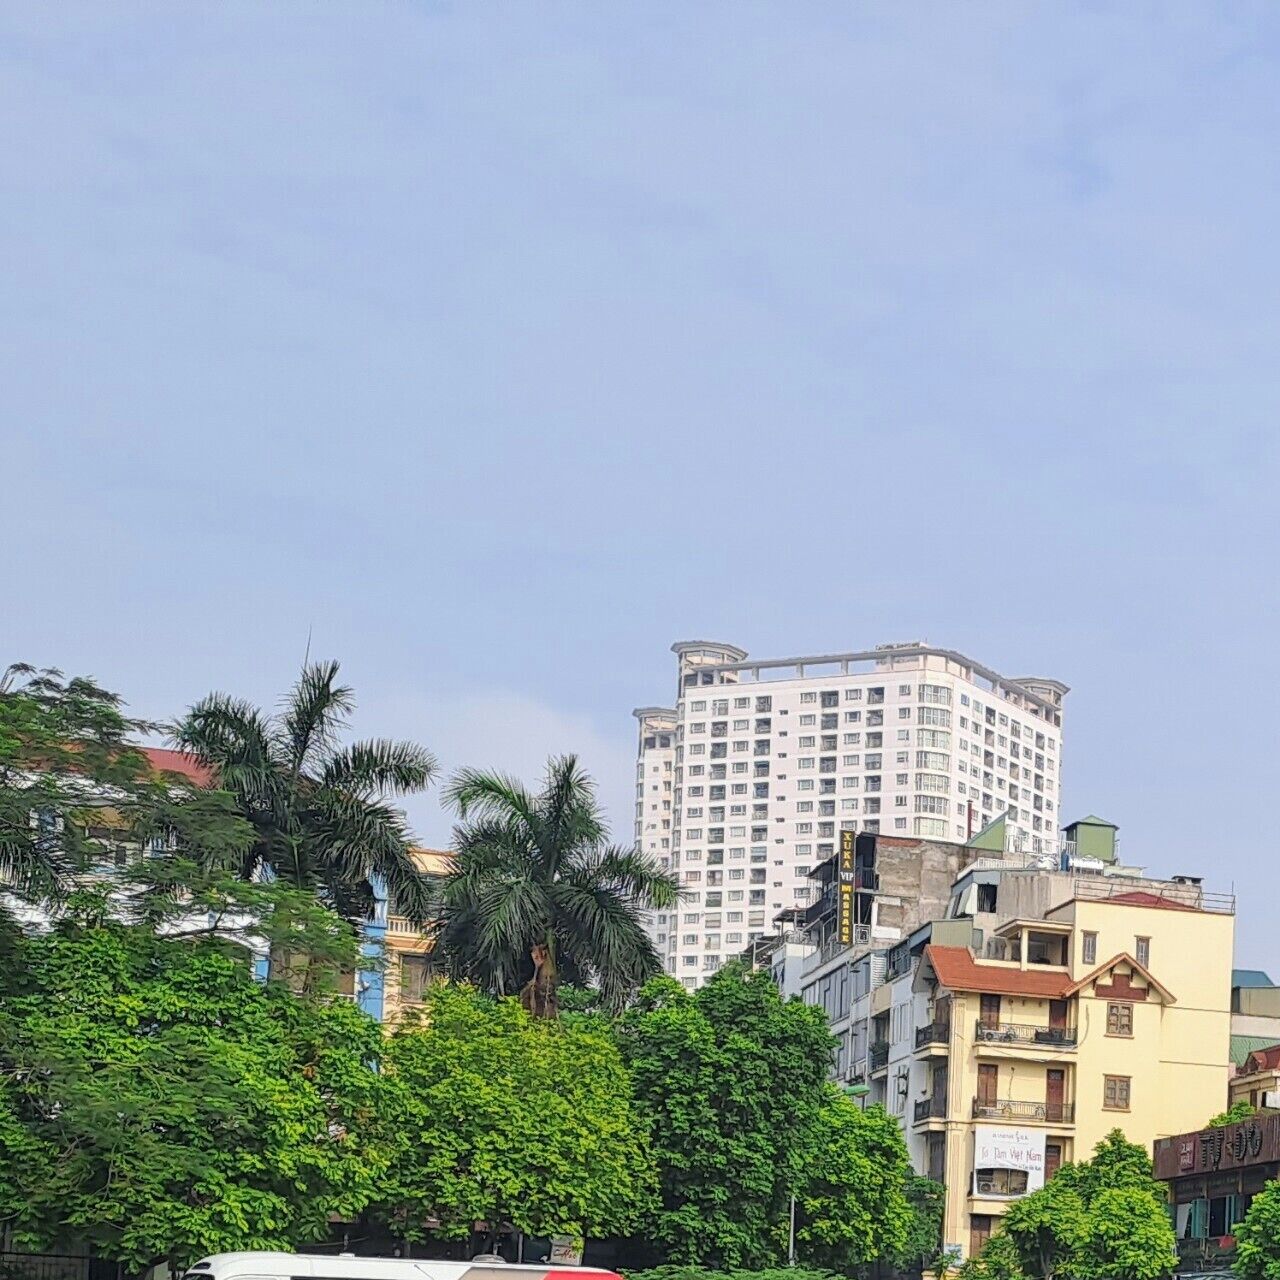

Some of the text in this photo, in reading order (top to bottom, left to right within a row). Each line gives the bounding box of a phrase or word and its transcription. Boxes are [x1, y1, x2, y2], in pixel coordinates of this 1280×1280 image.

[840, 832, 853, 943] XUKA VIP MASSAGE
